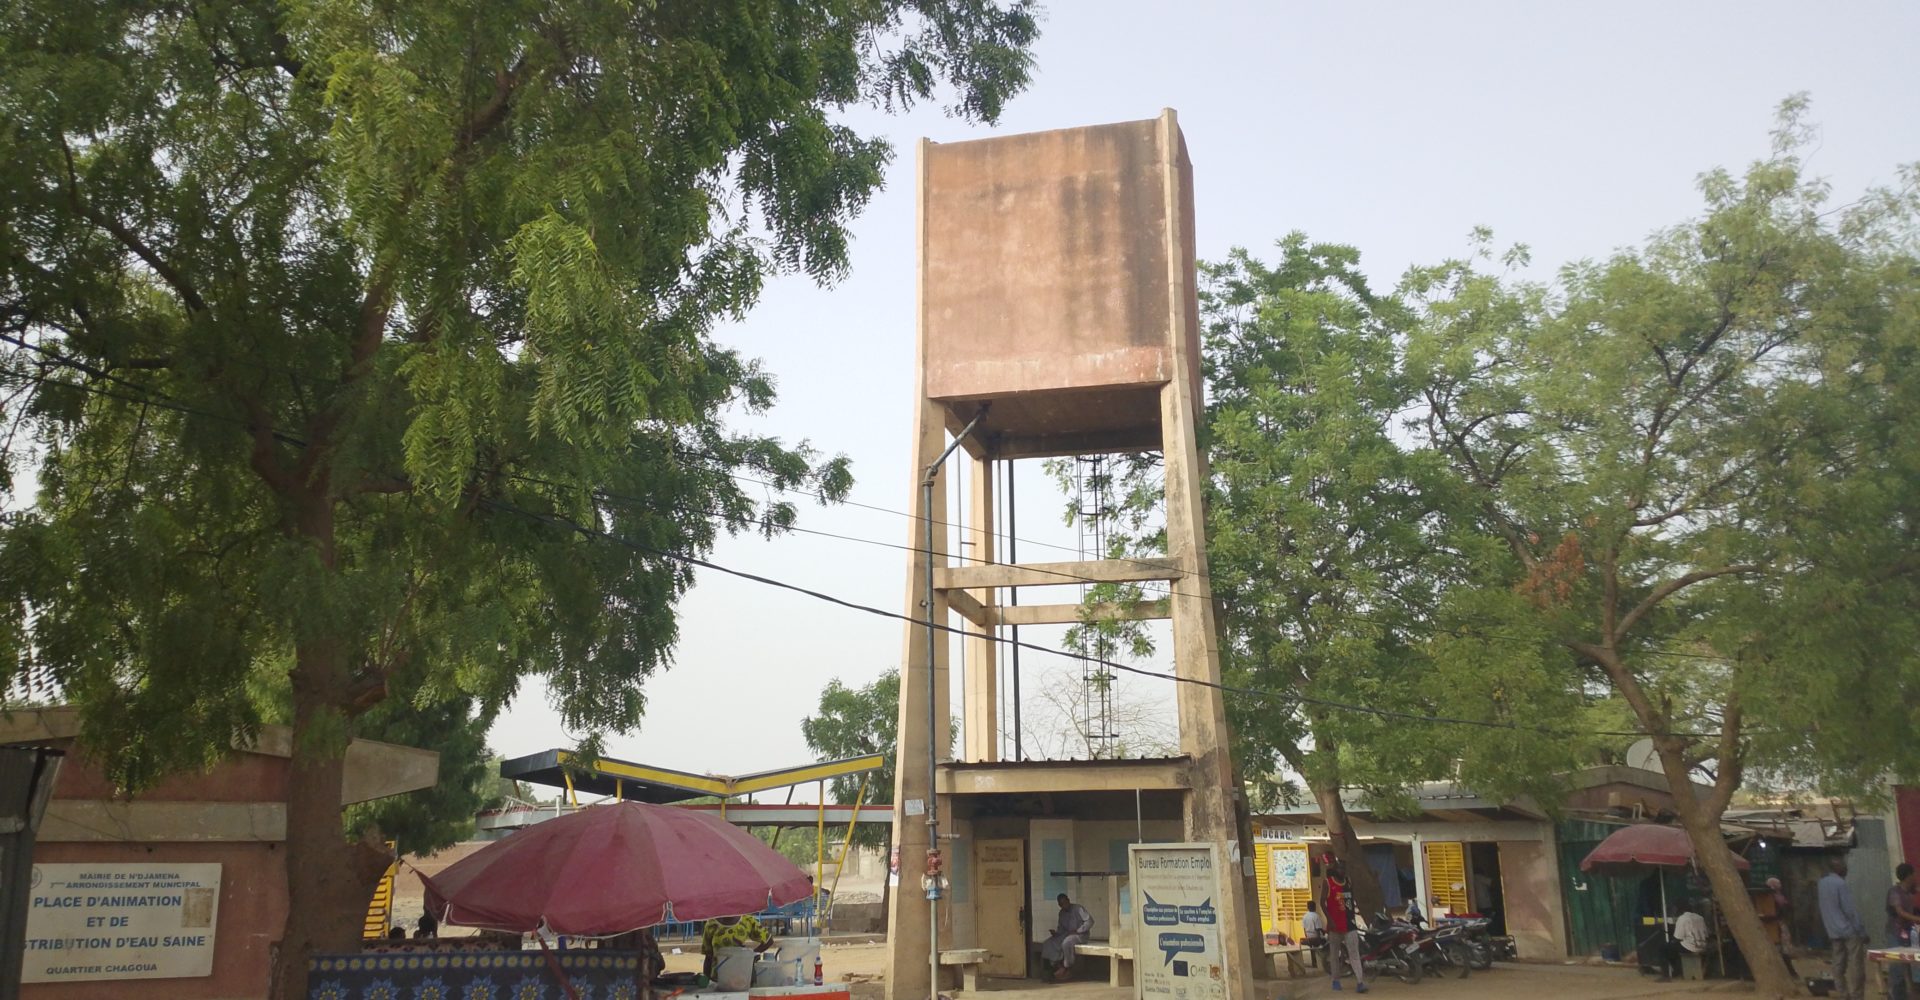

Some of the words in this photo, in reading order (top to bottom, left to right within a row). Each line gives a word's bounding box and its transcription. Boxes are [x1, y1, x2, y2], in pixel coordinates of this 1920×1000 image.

[1138, 857, 1160, 869] Bureau
[1160, 857, 1190, 869] Formation
[66, 881, 151, 889] ARRONDISSEMENT
[33, 897, 82, 908] PLACE
[86, 896, 182, 907] D'ANIMATION
[86, 917, 105, 928] ET
[110, 916, 129, 927] DE
[115, 937, 159, 948] D'EAU
[162, 936, 206, 947] SAINE
[46, 965, 102, 975] QUARTIER
[105, 964, 158, 973] CHAGOUA
